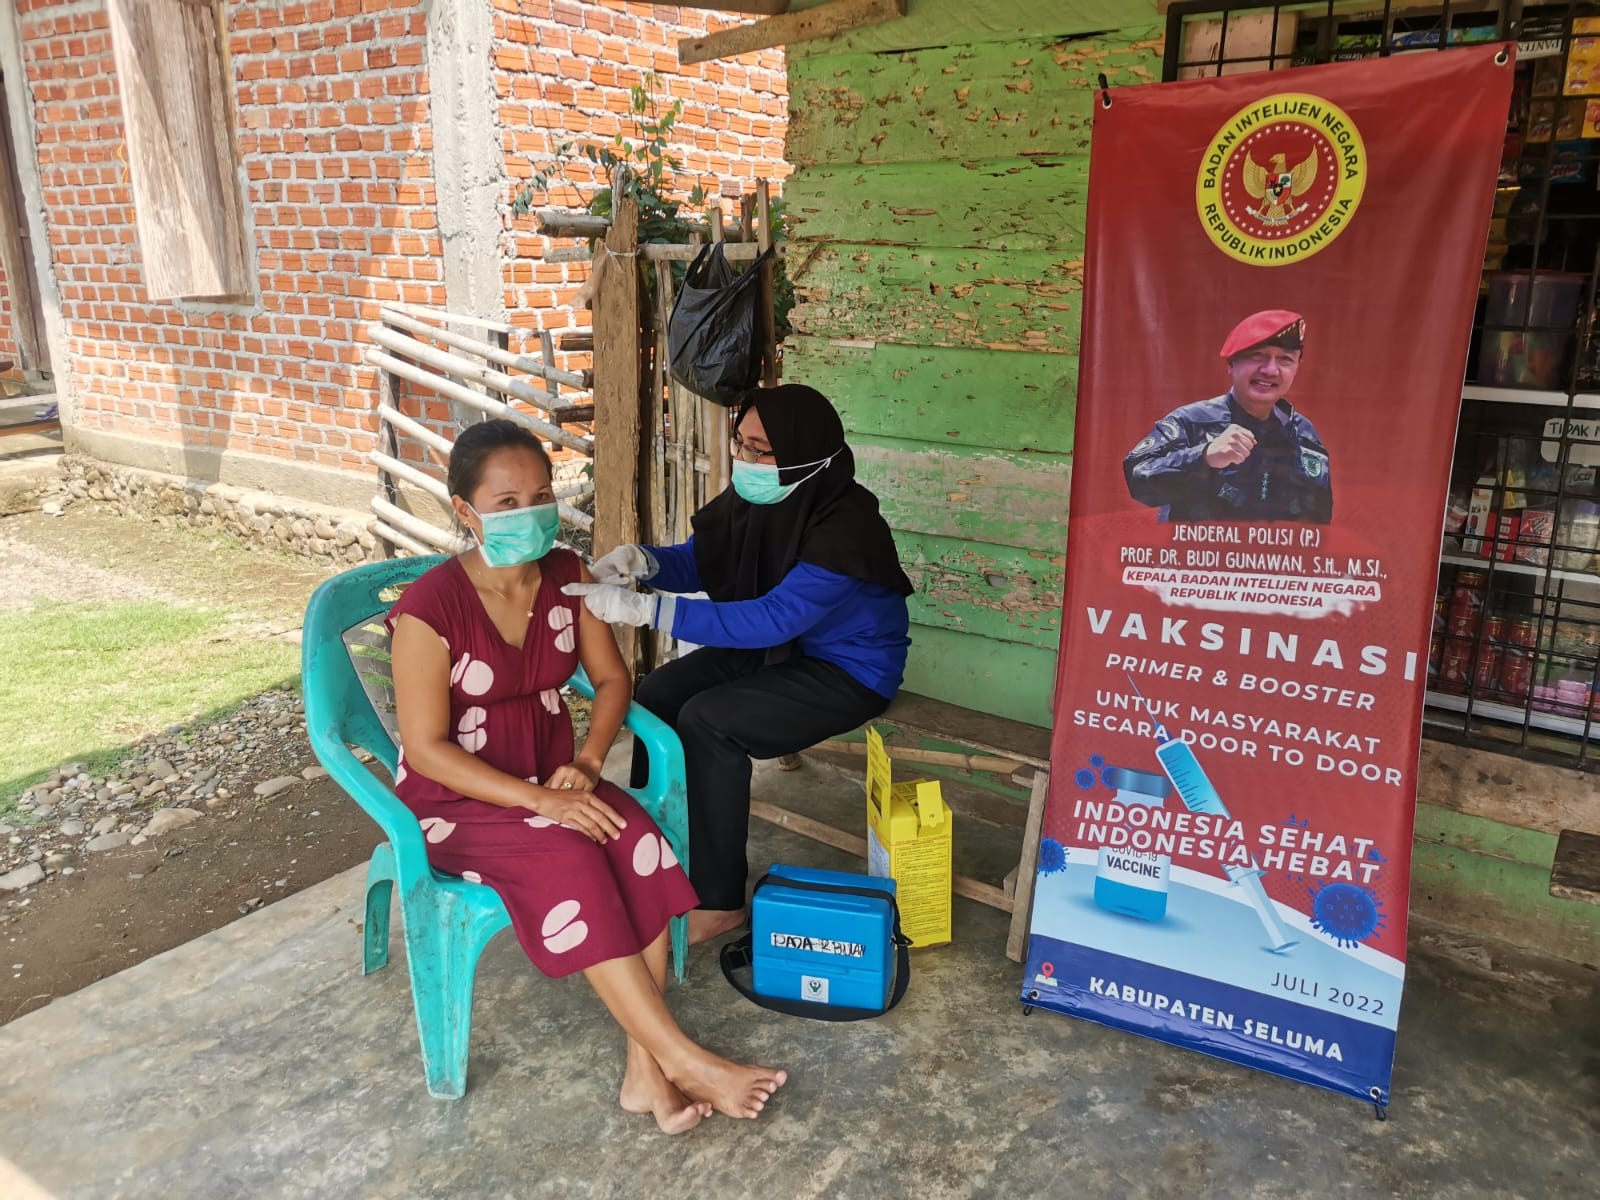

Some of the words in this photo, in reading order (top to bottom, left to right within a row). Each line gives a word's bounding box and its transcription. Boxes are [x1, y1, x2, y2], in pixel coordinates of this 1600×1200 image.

[1203, 131, 1236, 188] BADAN
[1235, 101, 1322, 133] INTELIJEN
[1321, 112, 1358, 180] NEGARA
[1205, 203, 1265, 259] REPUBLIK
[1269, 198, 1353, 259] INDONESIA
[1120, 547, 1154, 565] PROF.
[1160, 549, 1181, 566] DR.
[1187, 550, 1220, 567] BUDI
[1172, 524, 1241, 543] JENDERAL
[1249, 527, 1293, 546] POLISI
[1126, 570, 1177, 583] KEPALA
[1180, 574, 1230, 587] BADAN
[1234, 577, 1308, 592] INTELIJEN
[1311, 582, 1376, 597] NEGARA
[1170, 587, 1237, 601] REPUBLIK
[1240, 592, 1323, 608] INDONESIA
[1086, 607, 1417, 681] VAKSINASI
[1105, 653, 1203, 682] PRIMER
[1212, 669, 1228, 686] &
[1240, 673, 1375, 711] BOOSTER
[1073, 710, 1169, 741] SECARA
[1180, 728, 1257, 758] DOOR
[1268, 745, 1304, 766] TO
[1316, 754, 1402, 786] DOOR
[1096, 690, 1180, 719] UNTUK
[1190, 706, 1381, 754] MASYARAKAT
[1073, 799, 1245, 840] INDONESIA
[1258, 825, 1374, 859] SEHAT
[1077, 822, 1249, 864] INDONESIA
[1263, 849, 1380, 884] HEBAT
[1106, 854, 1161, 879] VACCINE
[1089, 976, 1234, 1030] KABUPATEN
[1243, 1018, 1343, 1062] SELUMA
[1271, 971, 1318, 997] JULI
[1328, 987, 1385, 1016] 2022
